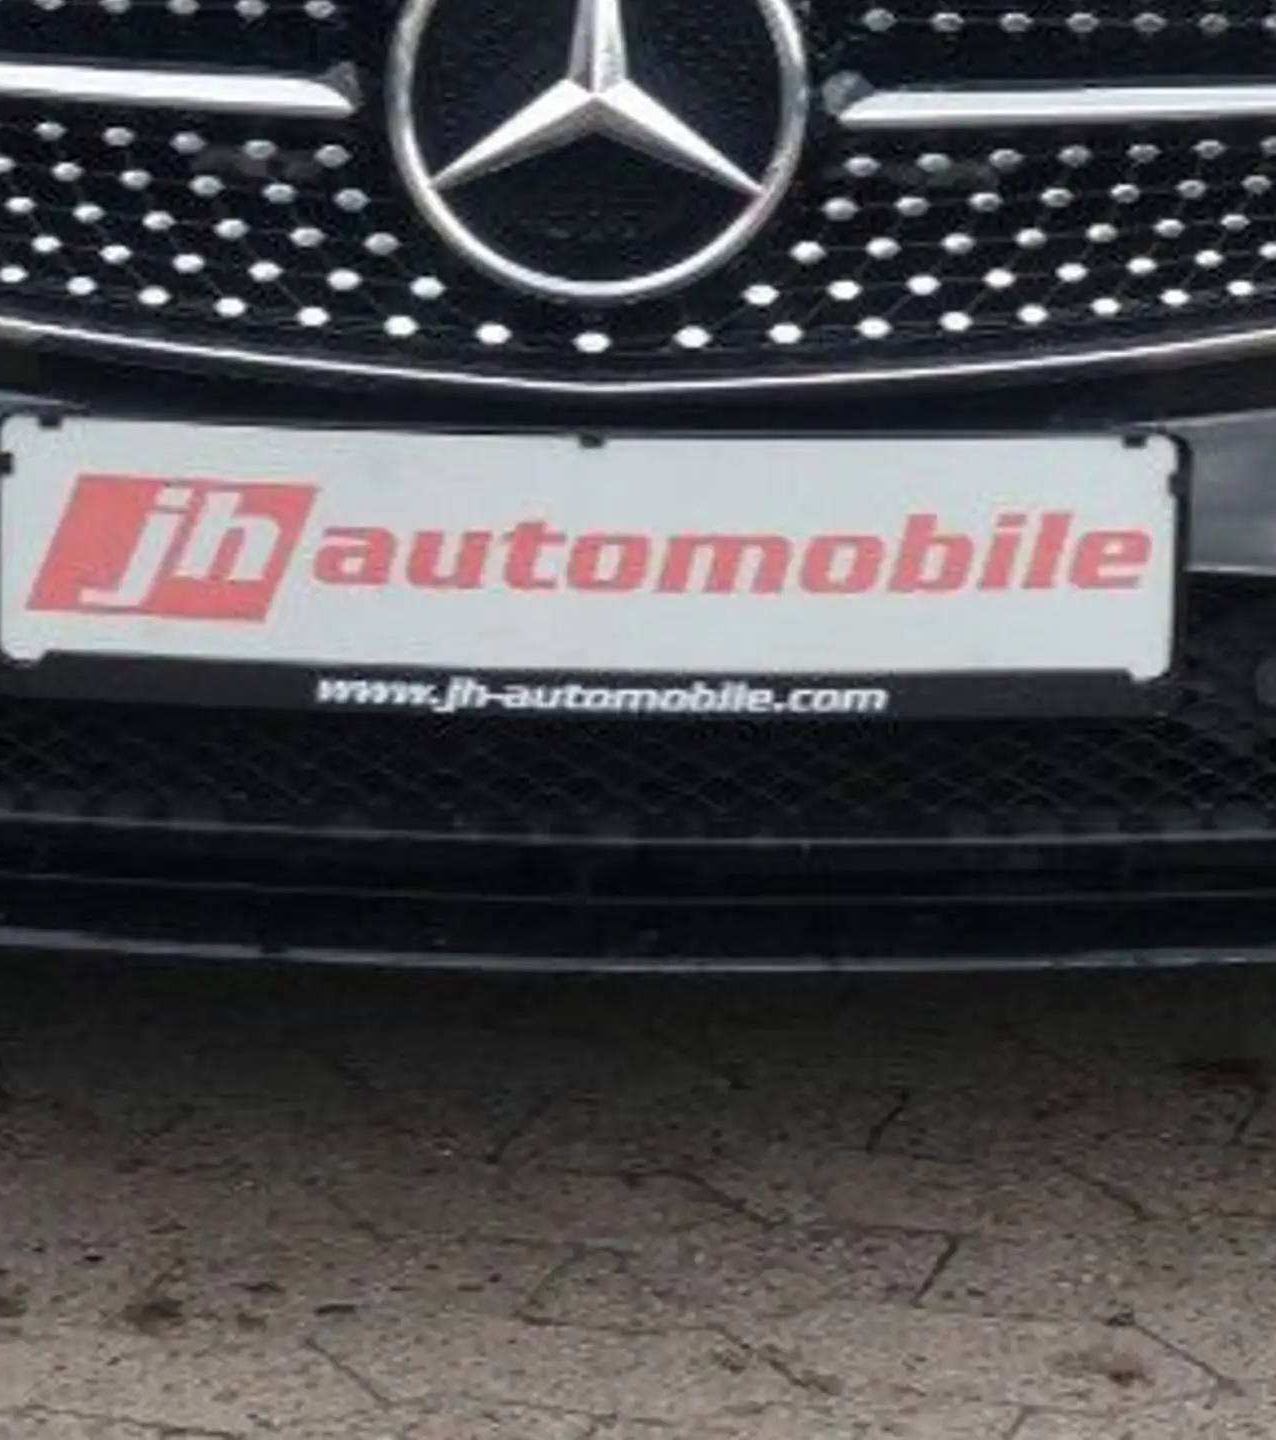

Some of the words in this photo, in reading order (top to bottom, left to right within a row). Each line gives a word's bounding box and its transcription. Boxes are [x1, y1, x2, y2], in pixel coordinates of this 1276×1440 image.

[77, 485, 281, 606] jh
[313, 512, 1150, 594] automobile
[314, 674, 890, 714] www.jh-automobile.com
